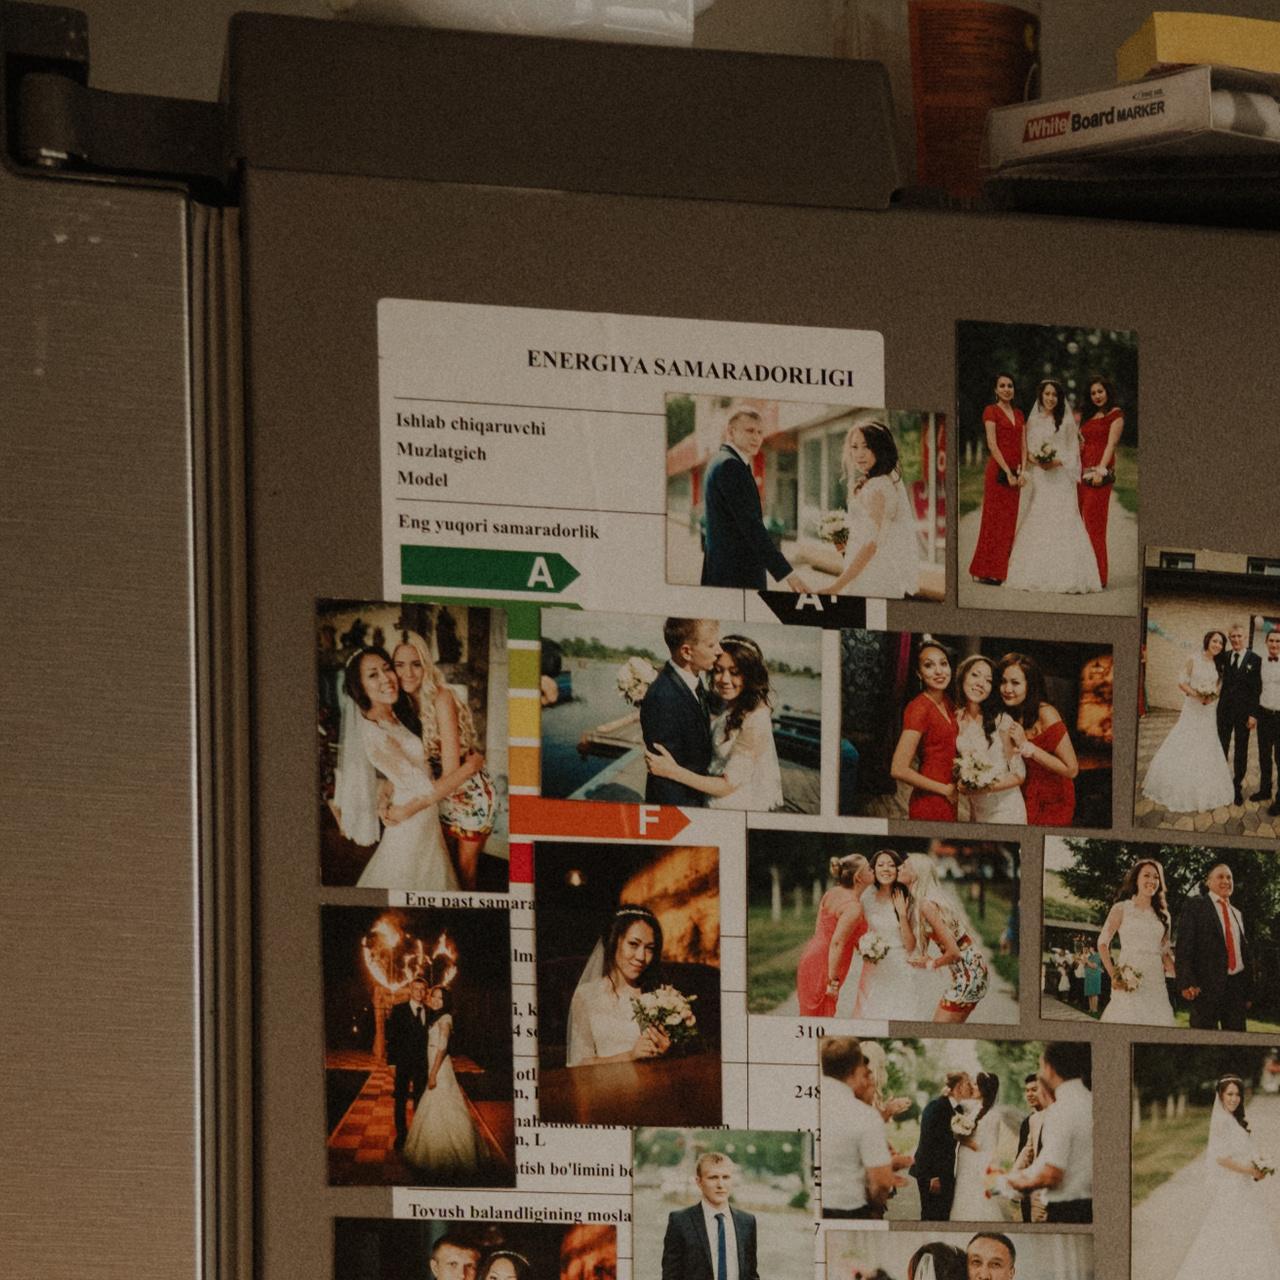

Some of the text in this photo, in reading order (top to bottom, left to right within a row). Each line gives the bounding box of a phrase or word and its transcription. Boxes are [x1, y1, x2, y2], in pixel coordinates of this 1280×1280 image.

[1025, 101, 1165, 141] White Board MARKER
[527, 349, 854, 387] ENERGIYA SAMARADORLIGI
[396, 410, 546, 438] Ishlab chiqaruvchi
[397, 440, 487, 464] Muzlatgich
[397, 470, 449, 489] Model
[398, 514, 600, 541] Eng yuqori samaradorlik
[527, 556, 554, 589] A
[638, 806, 661, 836] F
[405, 892, 437, 908] Eng
[442, 895, 475, 908] past
[795, 1025, 825, 1039] 310
[549, 1164, 614, 1178] bo'limini
[409, 1204, 464, 1218] Tovush
[470, 1205, 583, 1226] balandligining
